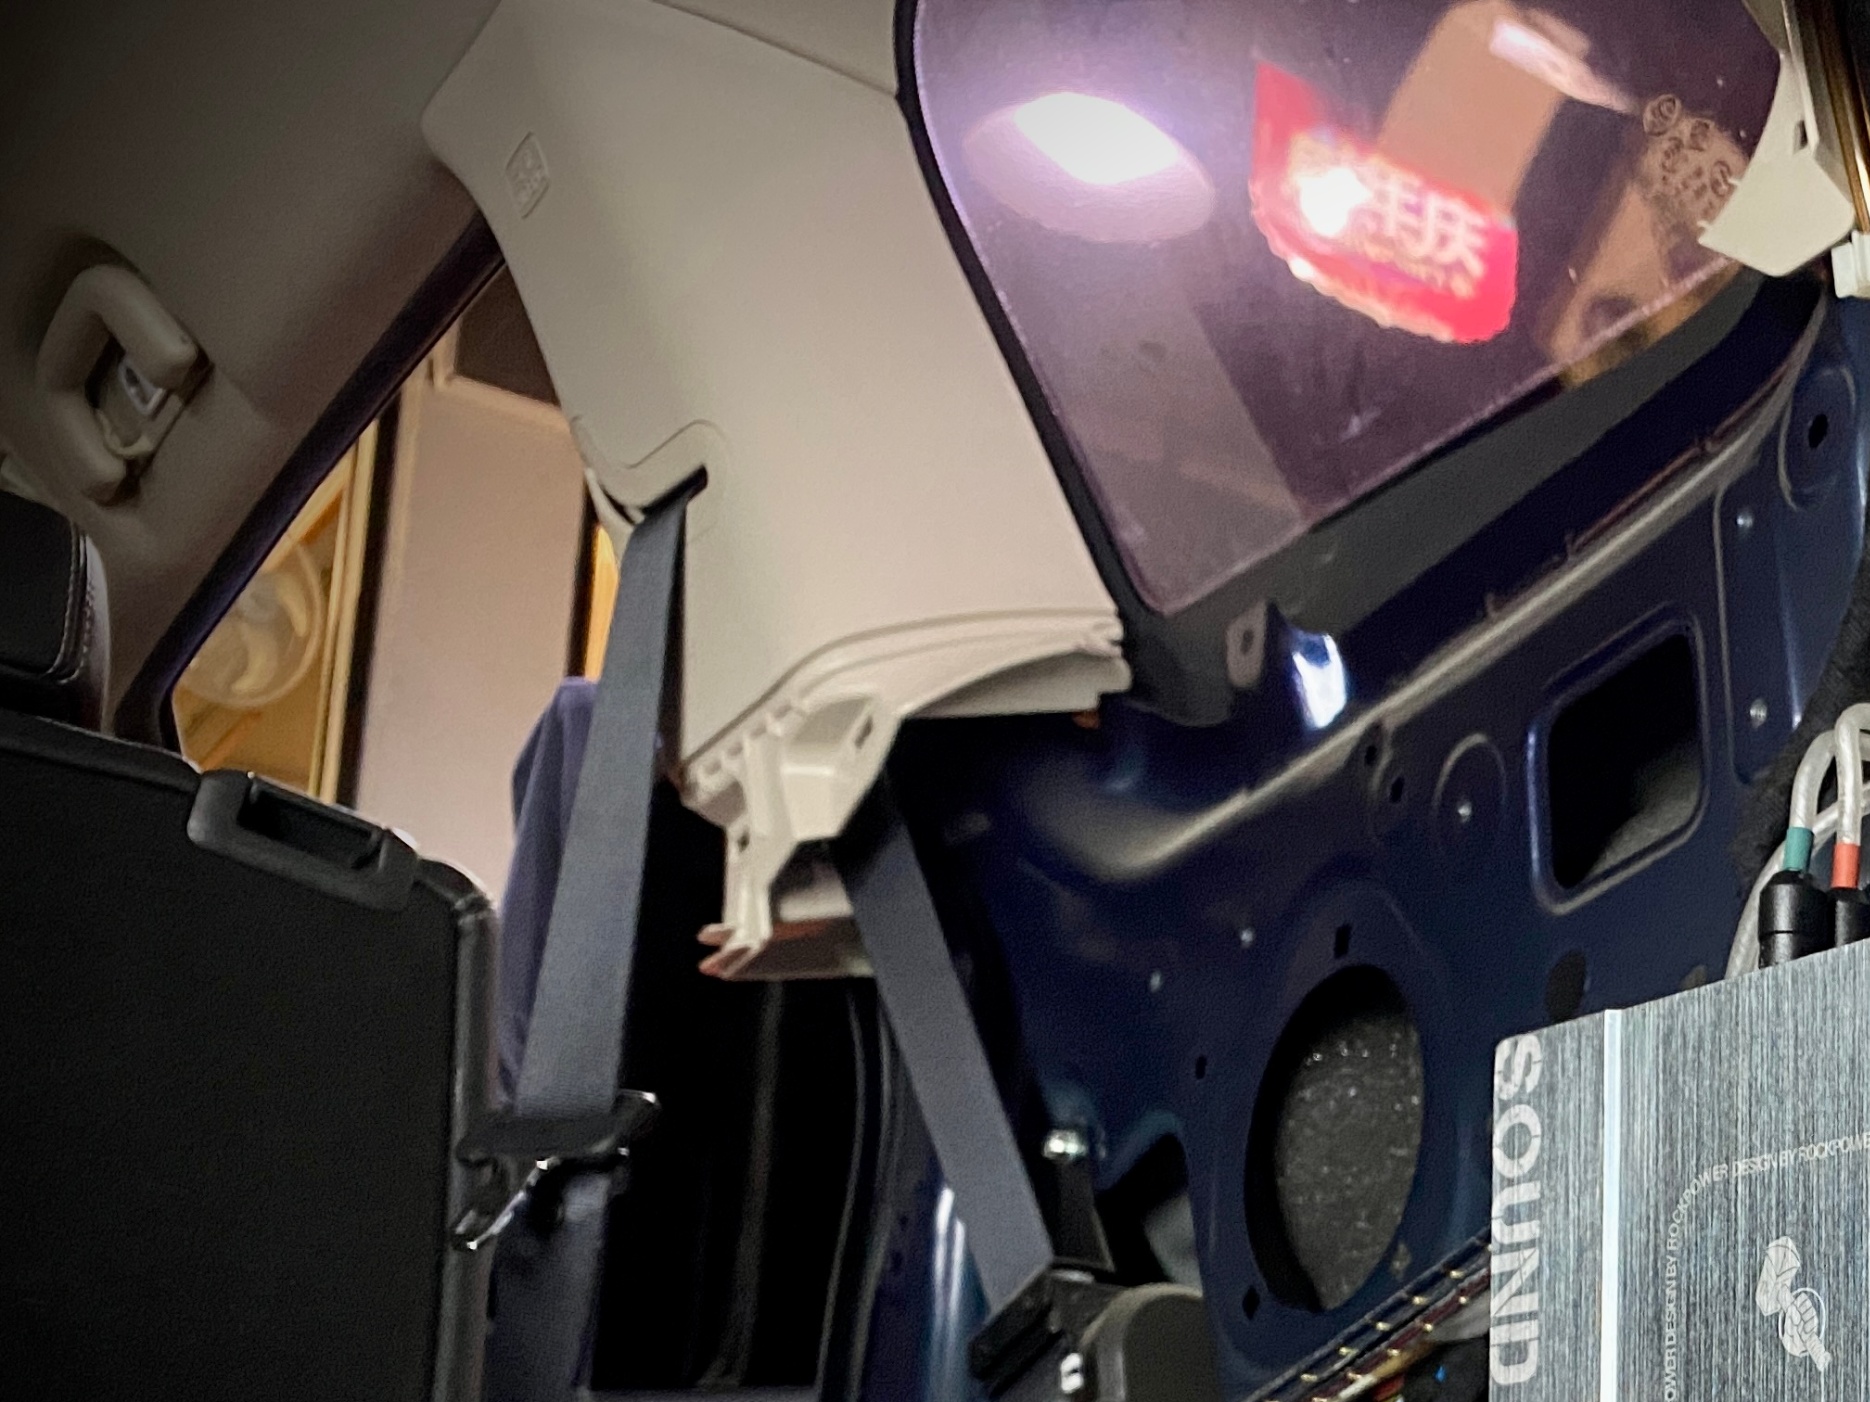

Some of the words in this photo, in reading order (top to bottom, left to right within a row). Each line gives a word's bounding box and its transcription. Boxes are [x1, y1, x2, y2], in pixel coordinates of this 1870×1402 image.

[1489, 1033, 1541, 1386] SOUND
[1666, 1163, 1729, 1251] ROCKPOWER
[1732, 1152, 1778, 1177] DESIGN
[1779, 1147, 1798, 1167] BY
